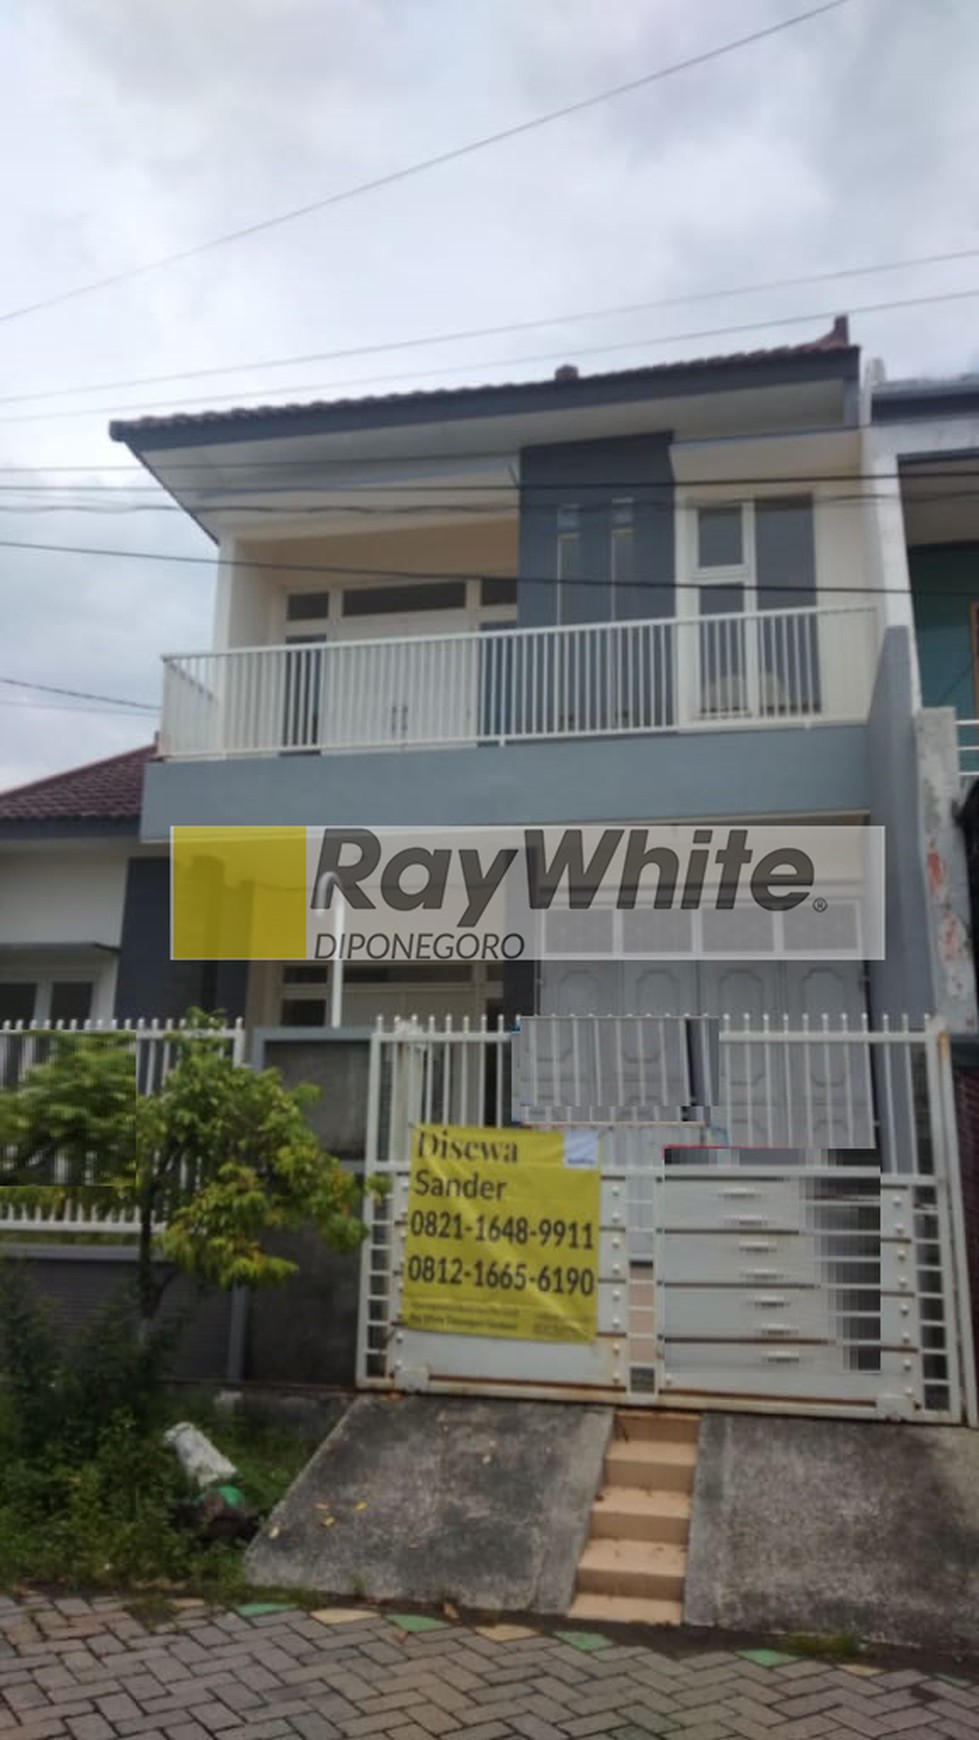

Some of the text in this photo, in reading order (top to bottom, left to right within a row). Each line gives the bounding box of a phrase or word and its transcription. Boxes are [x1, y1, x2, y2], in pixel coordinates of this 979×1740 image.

[417, 1129, 519, 1163] Disewa
[414, 1168, 507, 1202] Sander
[410, 1210, 594, 1250] 0821-1648-9911
[408, 1254, 595, 1297] 0812-1665-6190
